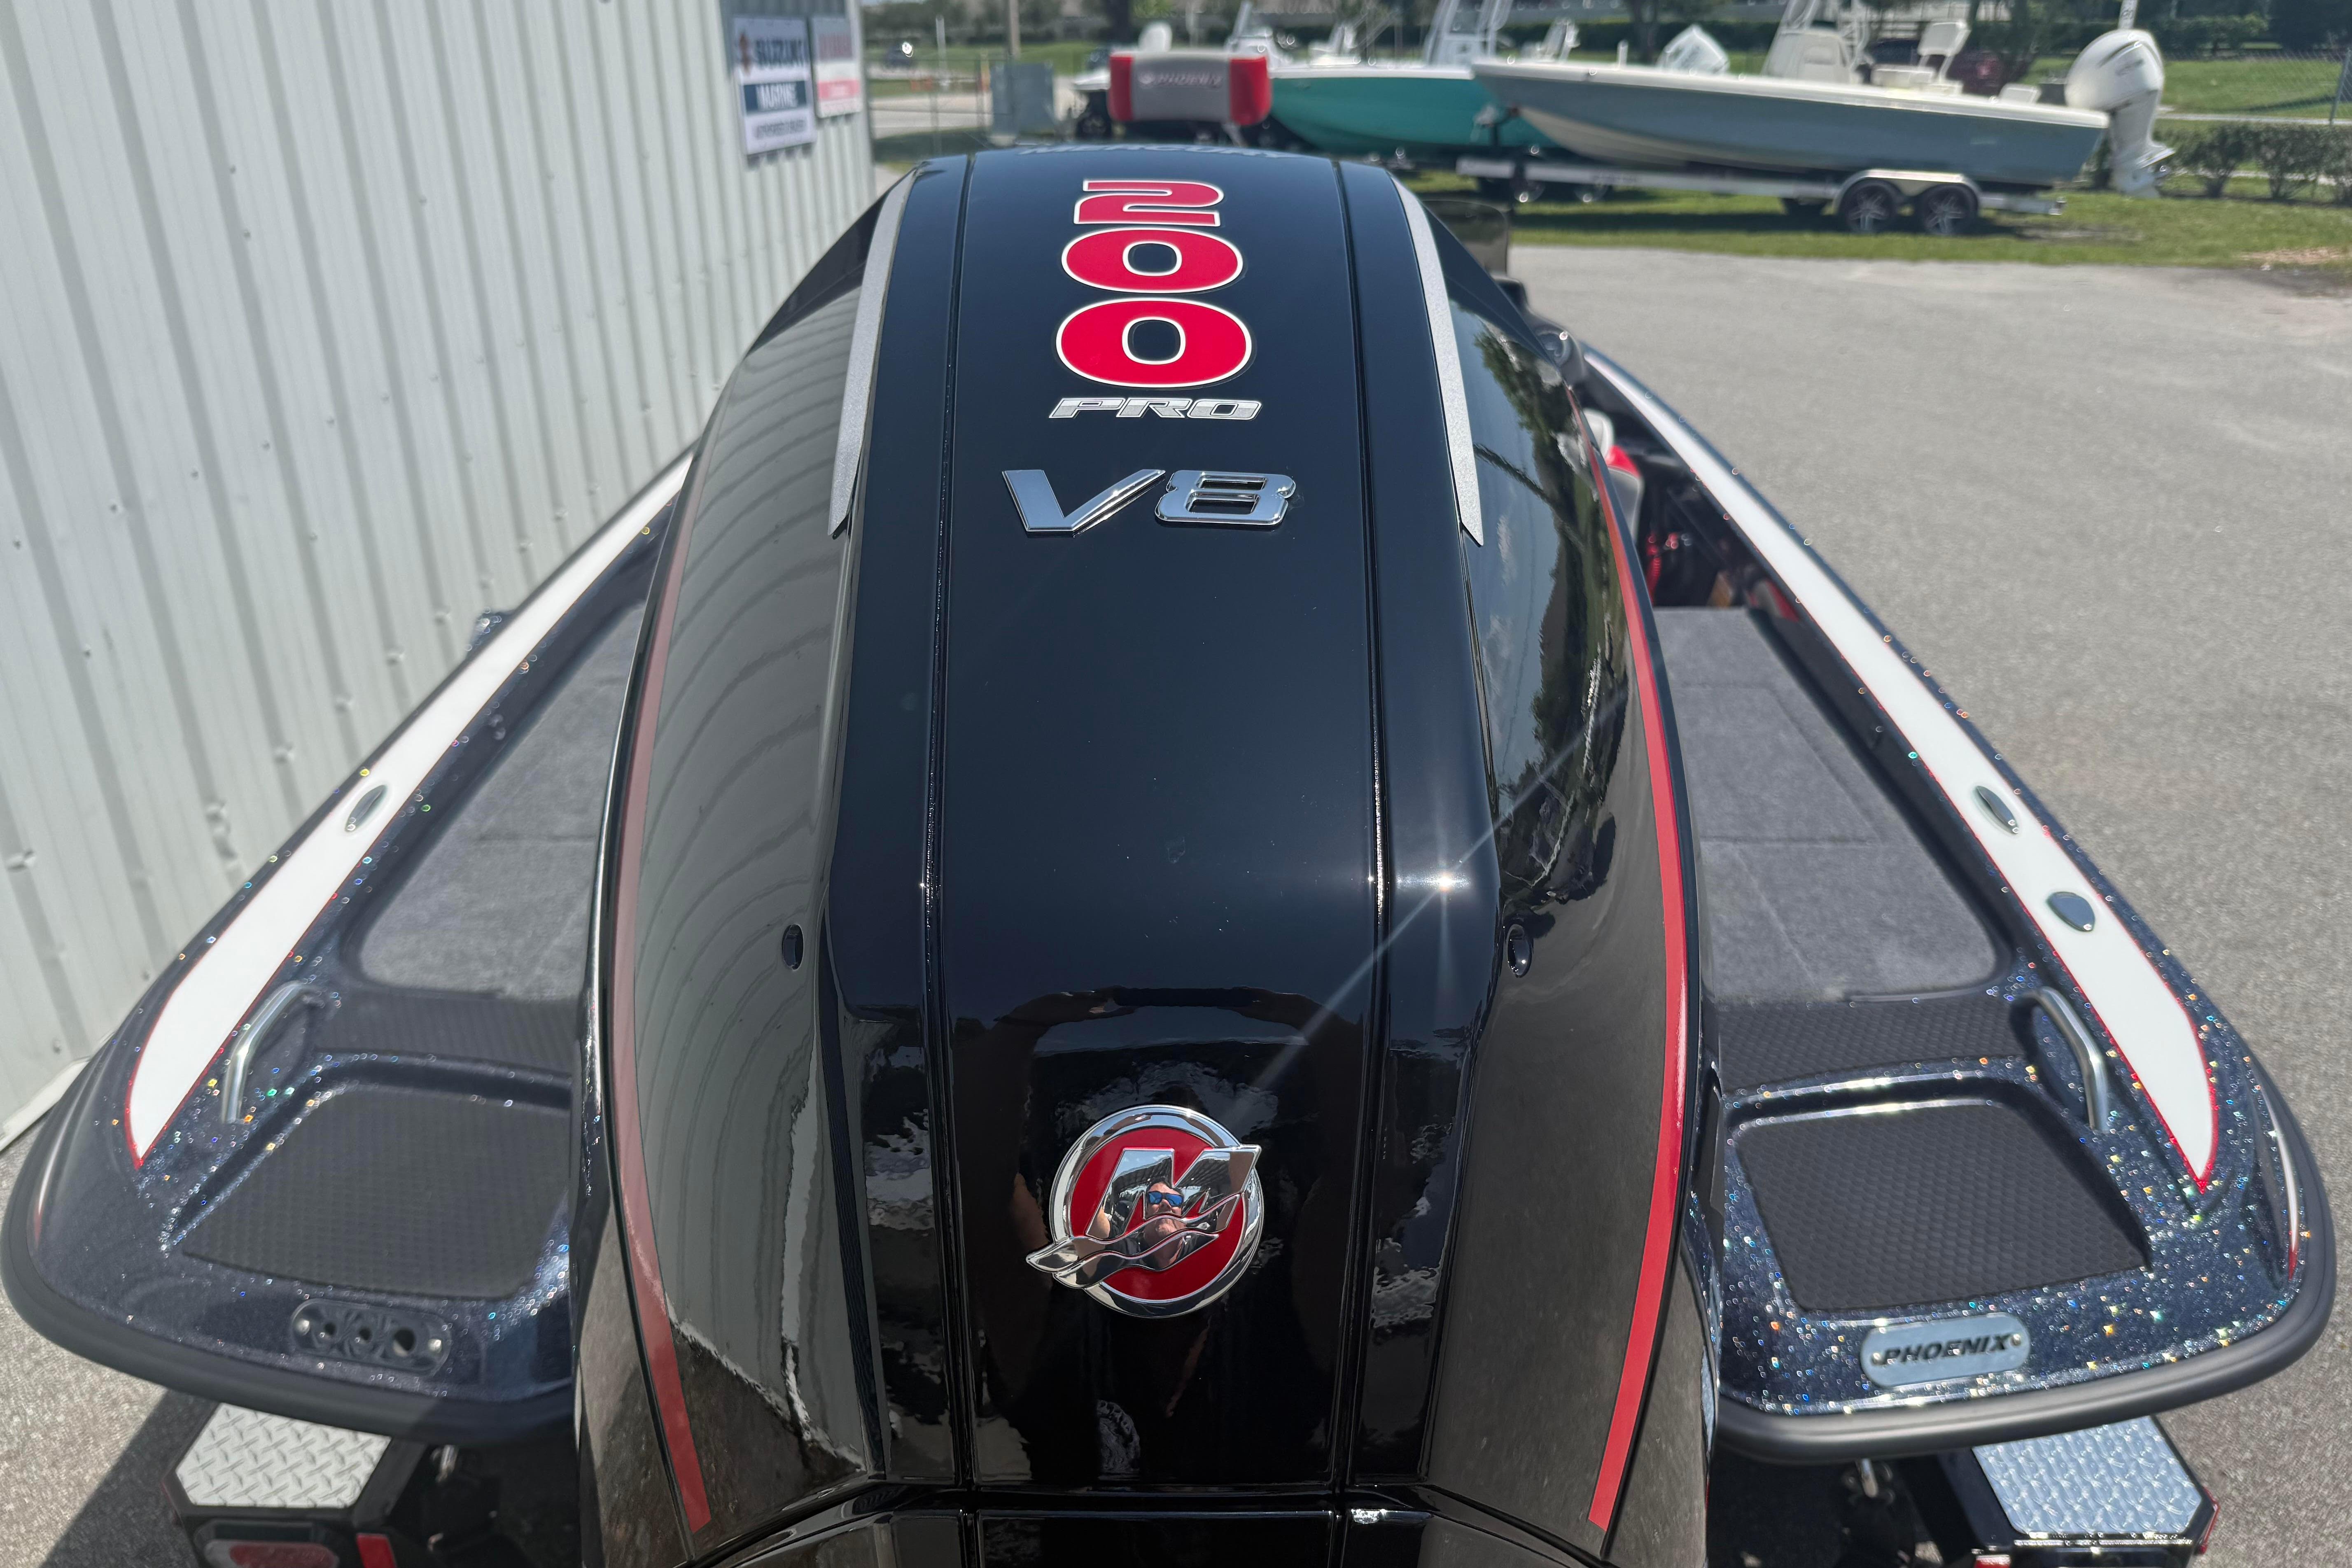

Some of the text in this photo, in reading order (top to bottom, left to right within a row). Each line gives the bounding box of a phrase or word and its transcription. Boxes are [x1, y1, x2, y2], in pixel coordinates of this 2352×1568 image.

[1056, 179, 1252, 387] 200
[1048, 397, 1262, 420] PRO
[1001, 469, 1296, 537] V8
[1881, 1332, 2013, 1365] PHOENIX
